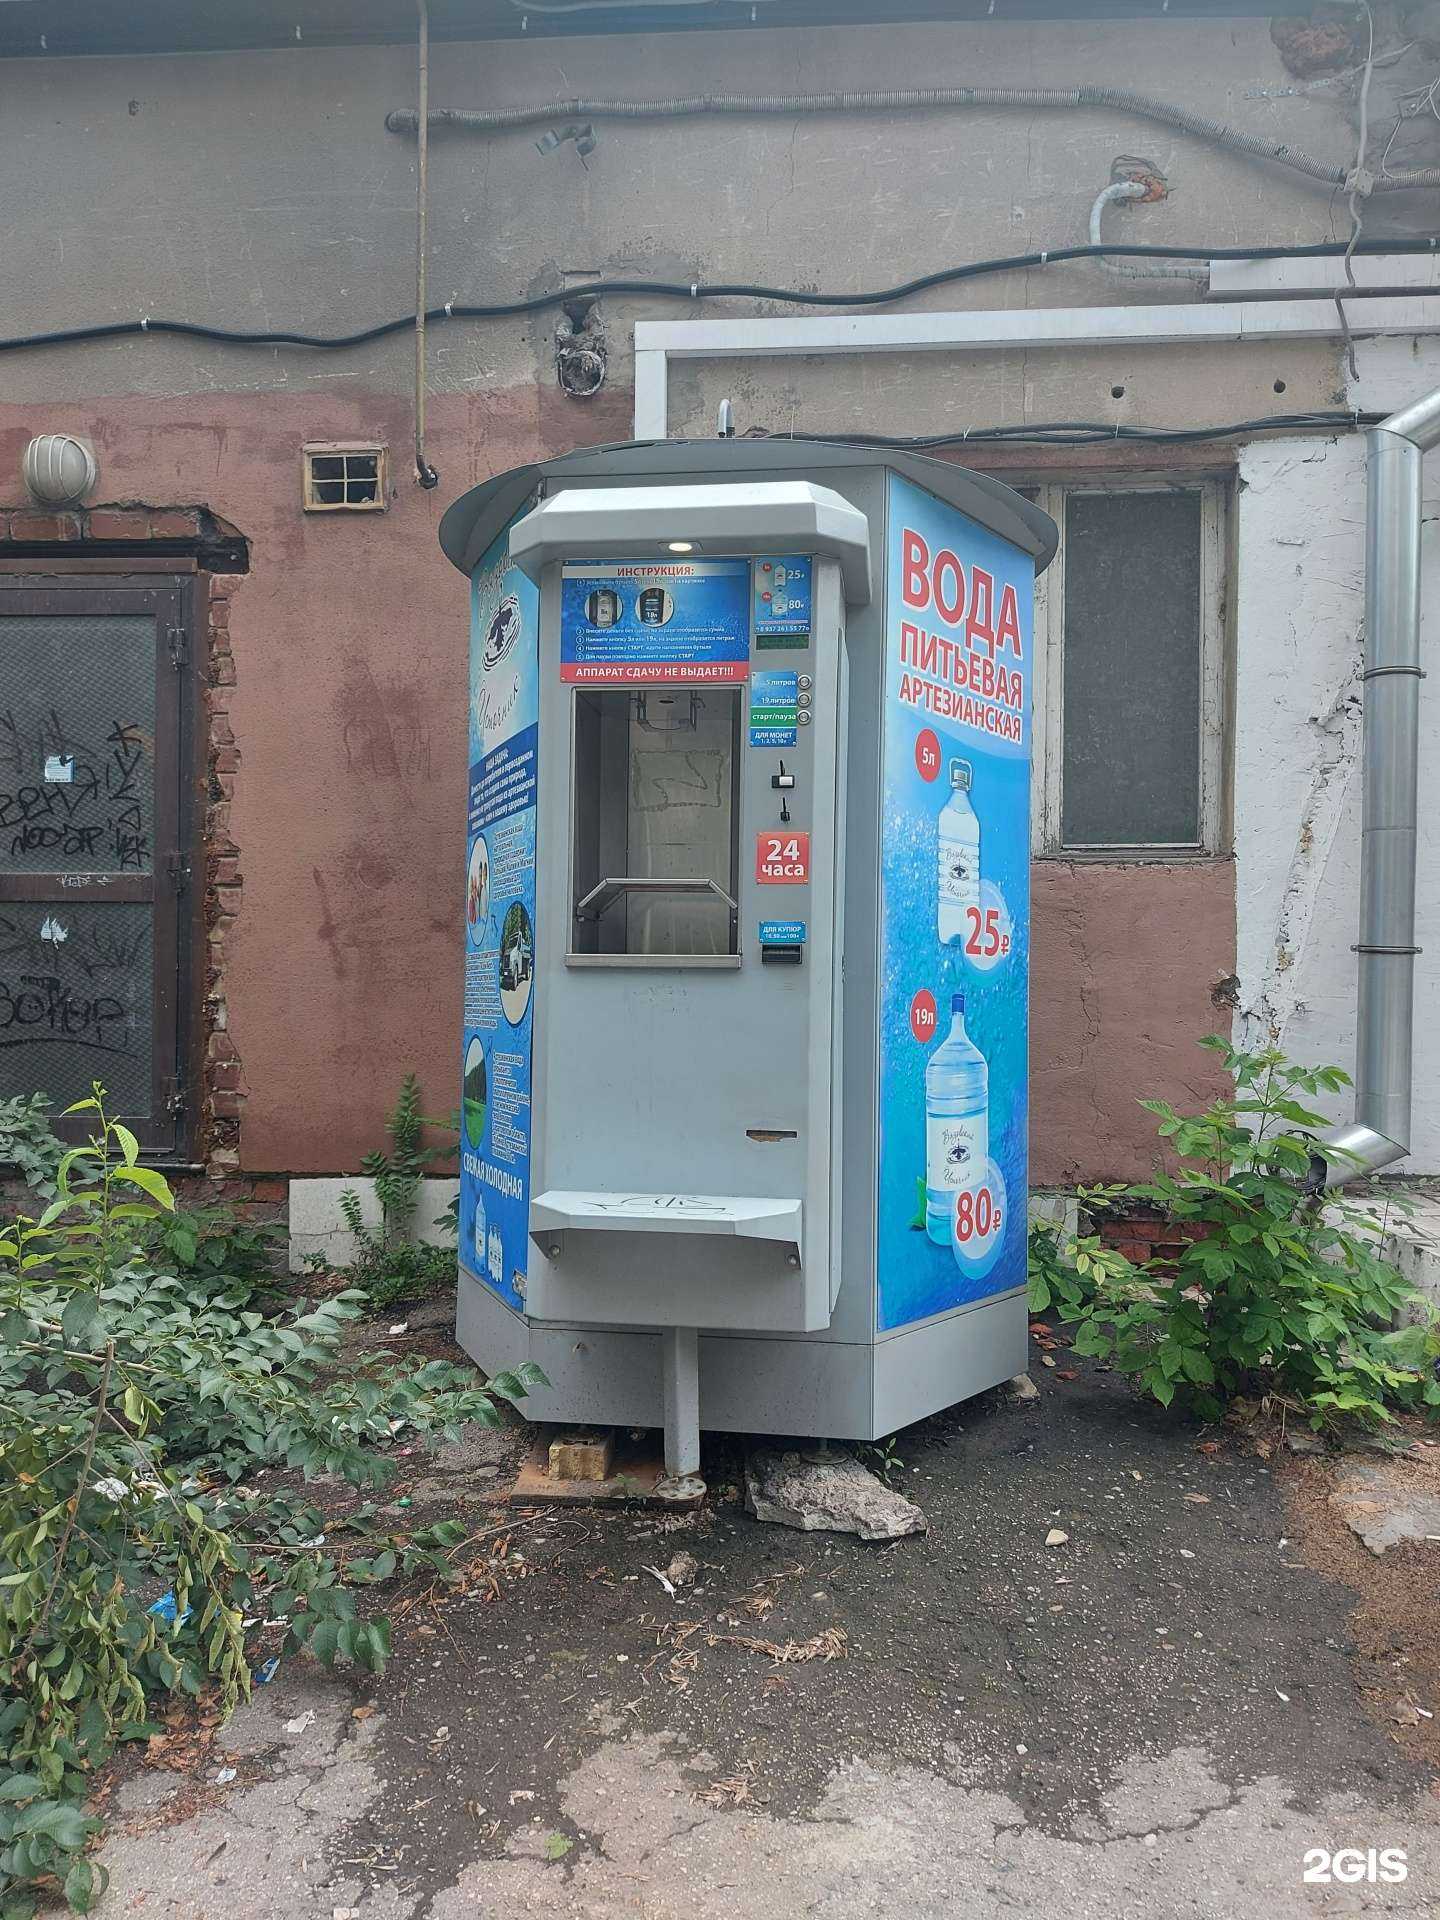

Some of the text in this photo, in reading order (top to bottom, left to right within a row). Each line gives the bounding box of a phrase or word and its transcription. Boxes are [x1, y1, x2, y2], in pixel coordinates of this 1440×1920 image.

[617, 566, 694, 576] ИНСТРУКЦИЯ:
[902, 527, 1022, 657] ВОДА
[576, 667, 624, 677] АППАРАТ
[626, 667, 661, 678] СДАЧУ
[664, 667, 678, 676] НЕ
[901, 622, 1022, 710] ПИТЬЕВАЯ
[770, 697, 795, 705] литров
[900, 673, 1021, 742] АРТЕЗИАНСКАЯ
[752, 713, 797, 722] старт/пауза
[922, 747, 935, 766] 5л
[766, 840, 800, 860] 24
[761, 864, 805, 876] часа
[915, 1008, 934, 1026] 19л
[463, 1153, 485, 1182] СВЕЖАЯ
[485, 1164, 523, 1201] ХОЛОДНАЯ
